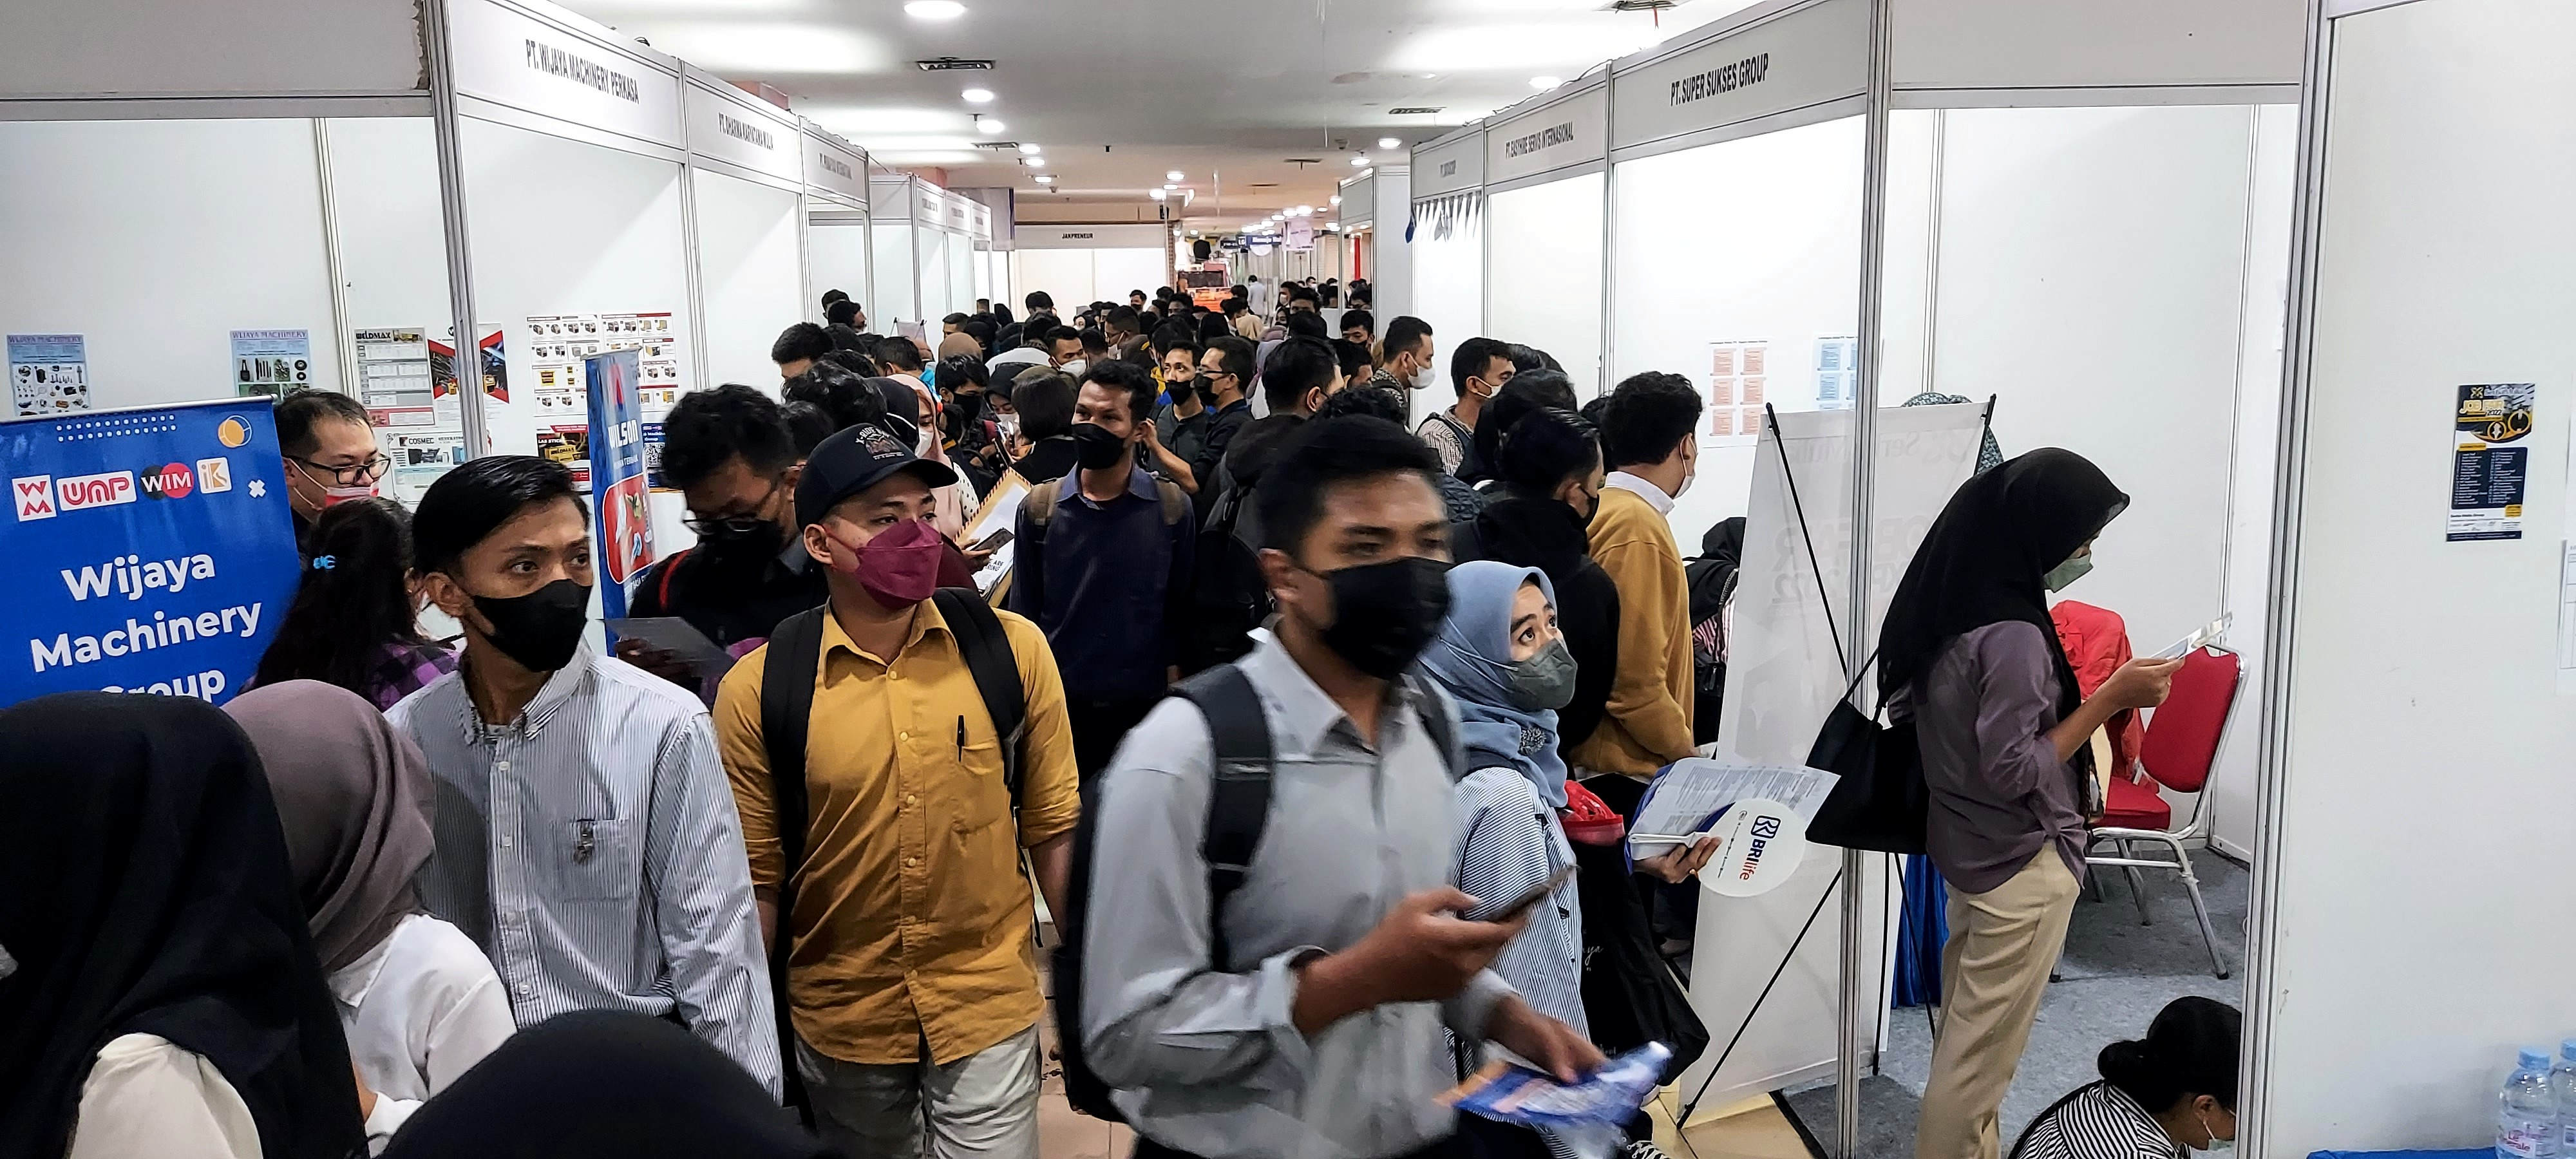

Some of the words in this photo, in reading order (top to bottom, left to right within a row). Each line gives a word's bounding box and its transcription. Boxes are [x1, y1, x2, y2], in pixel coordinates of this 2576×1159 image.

[526, 39, 539, 69] PT.
[539, 42, 569, 79] WIJAYA
[569, 53, 609, 93] MACHINERY
[611, 71, 639, 104] PERKASA
[1671, 80, 1681, 107] PT.
[1682, 73, 1705, 104] SUPER
[1706, 62, 1737, 97] SUKSES
[1739, 53, 1769, 88] GROUP
[1542, 121, 1574, 149] INTERNASIONAL
[608, 419, 639, 449] WILSON
[141, 471, 192, 493] WIM
[61, 553, 216, 601] Wijaya
[31, 603, 262, 672] Machinery
[100, 670, 225, 702] oup
